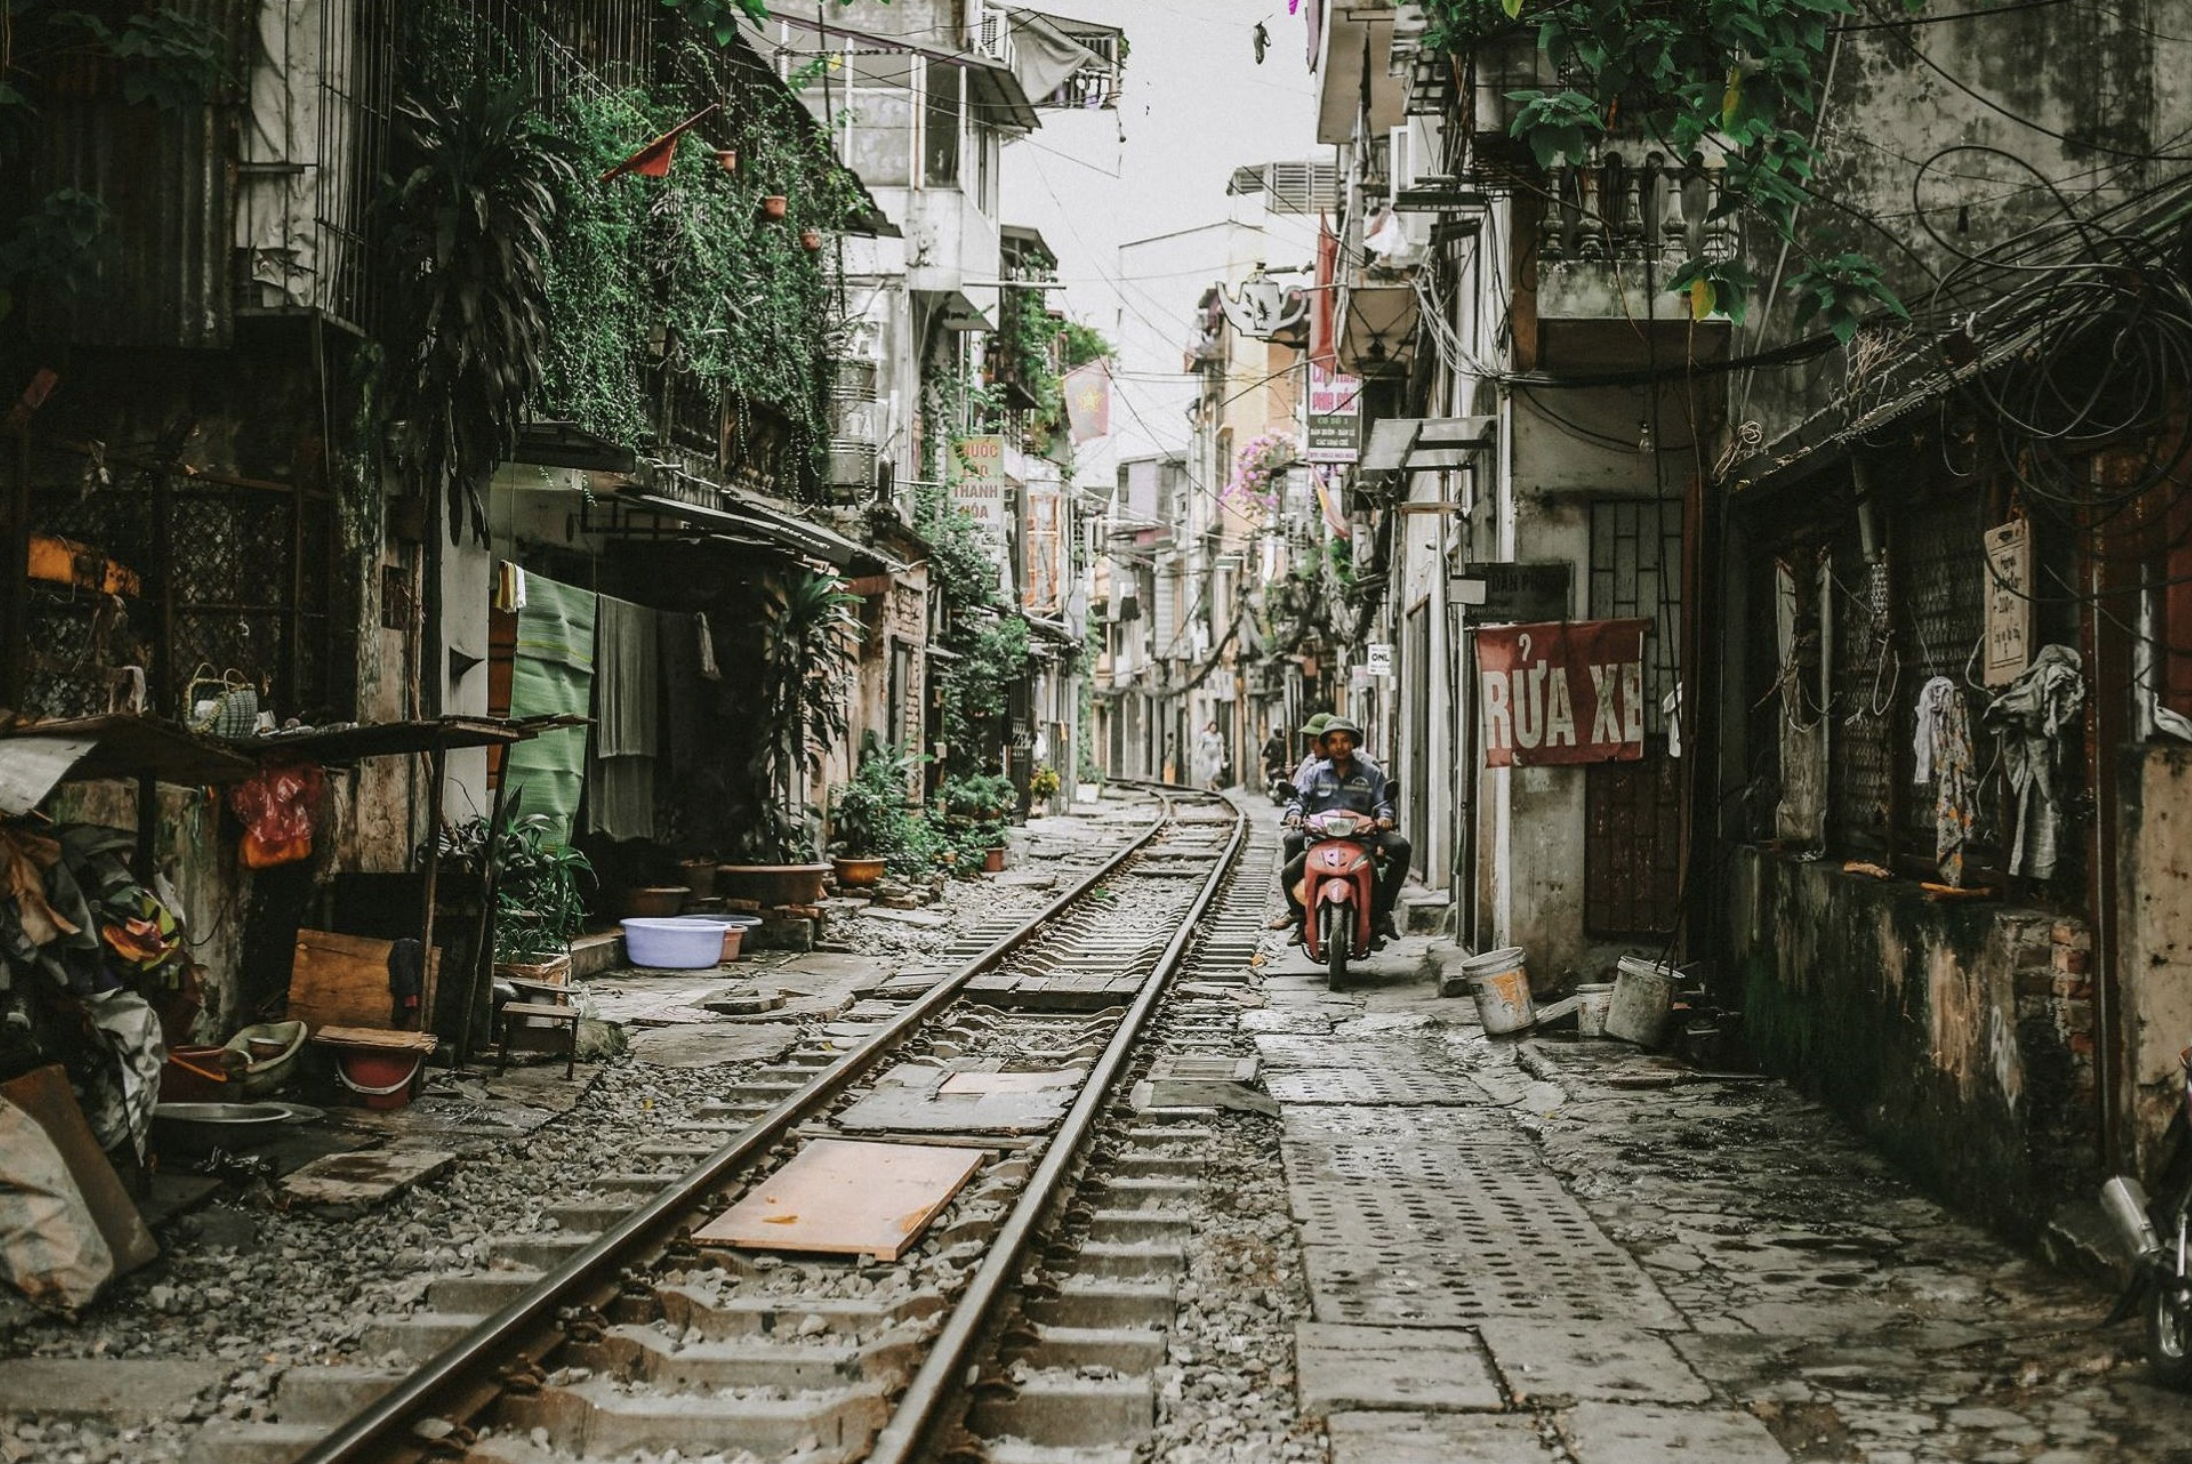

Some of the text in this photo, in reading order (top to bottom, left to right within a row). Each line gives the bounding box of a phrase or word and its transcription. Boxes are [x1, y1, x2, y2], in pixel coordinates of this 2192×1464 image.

[954, 484, 998, 498] THANH
[1482, 633, 1641, 749] RỬA XE
